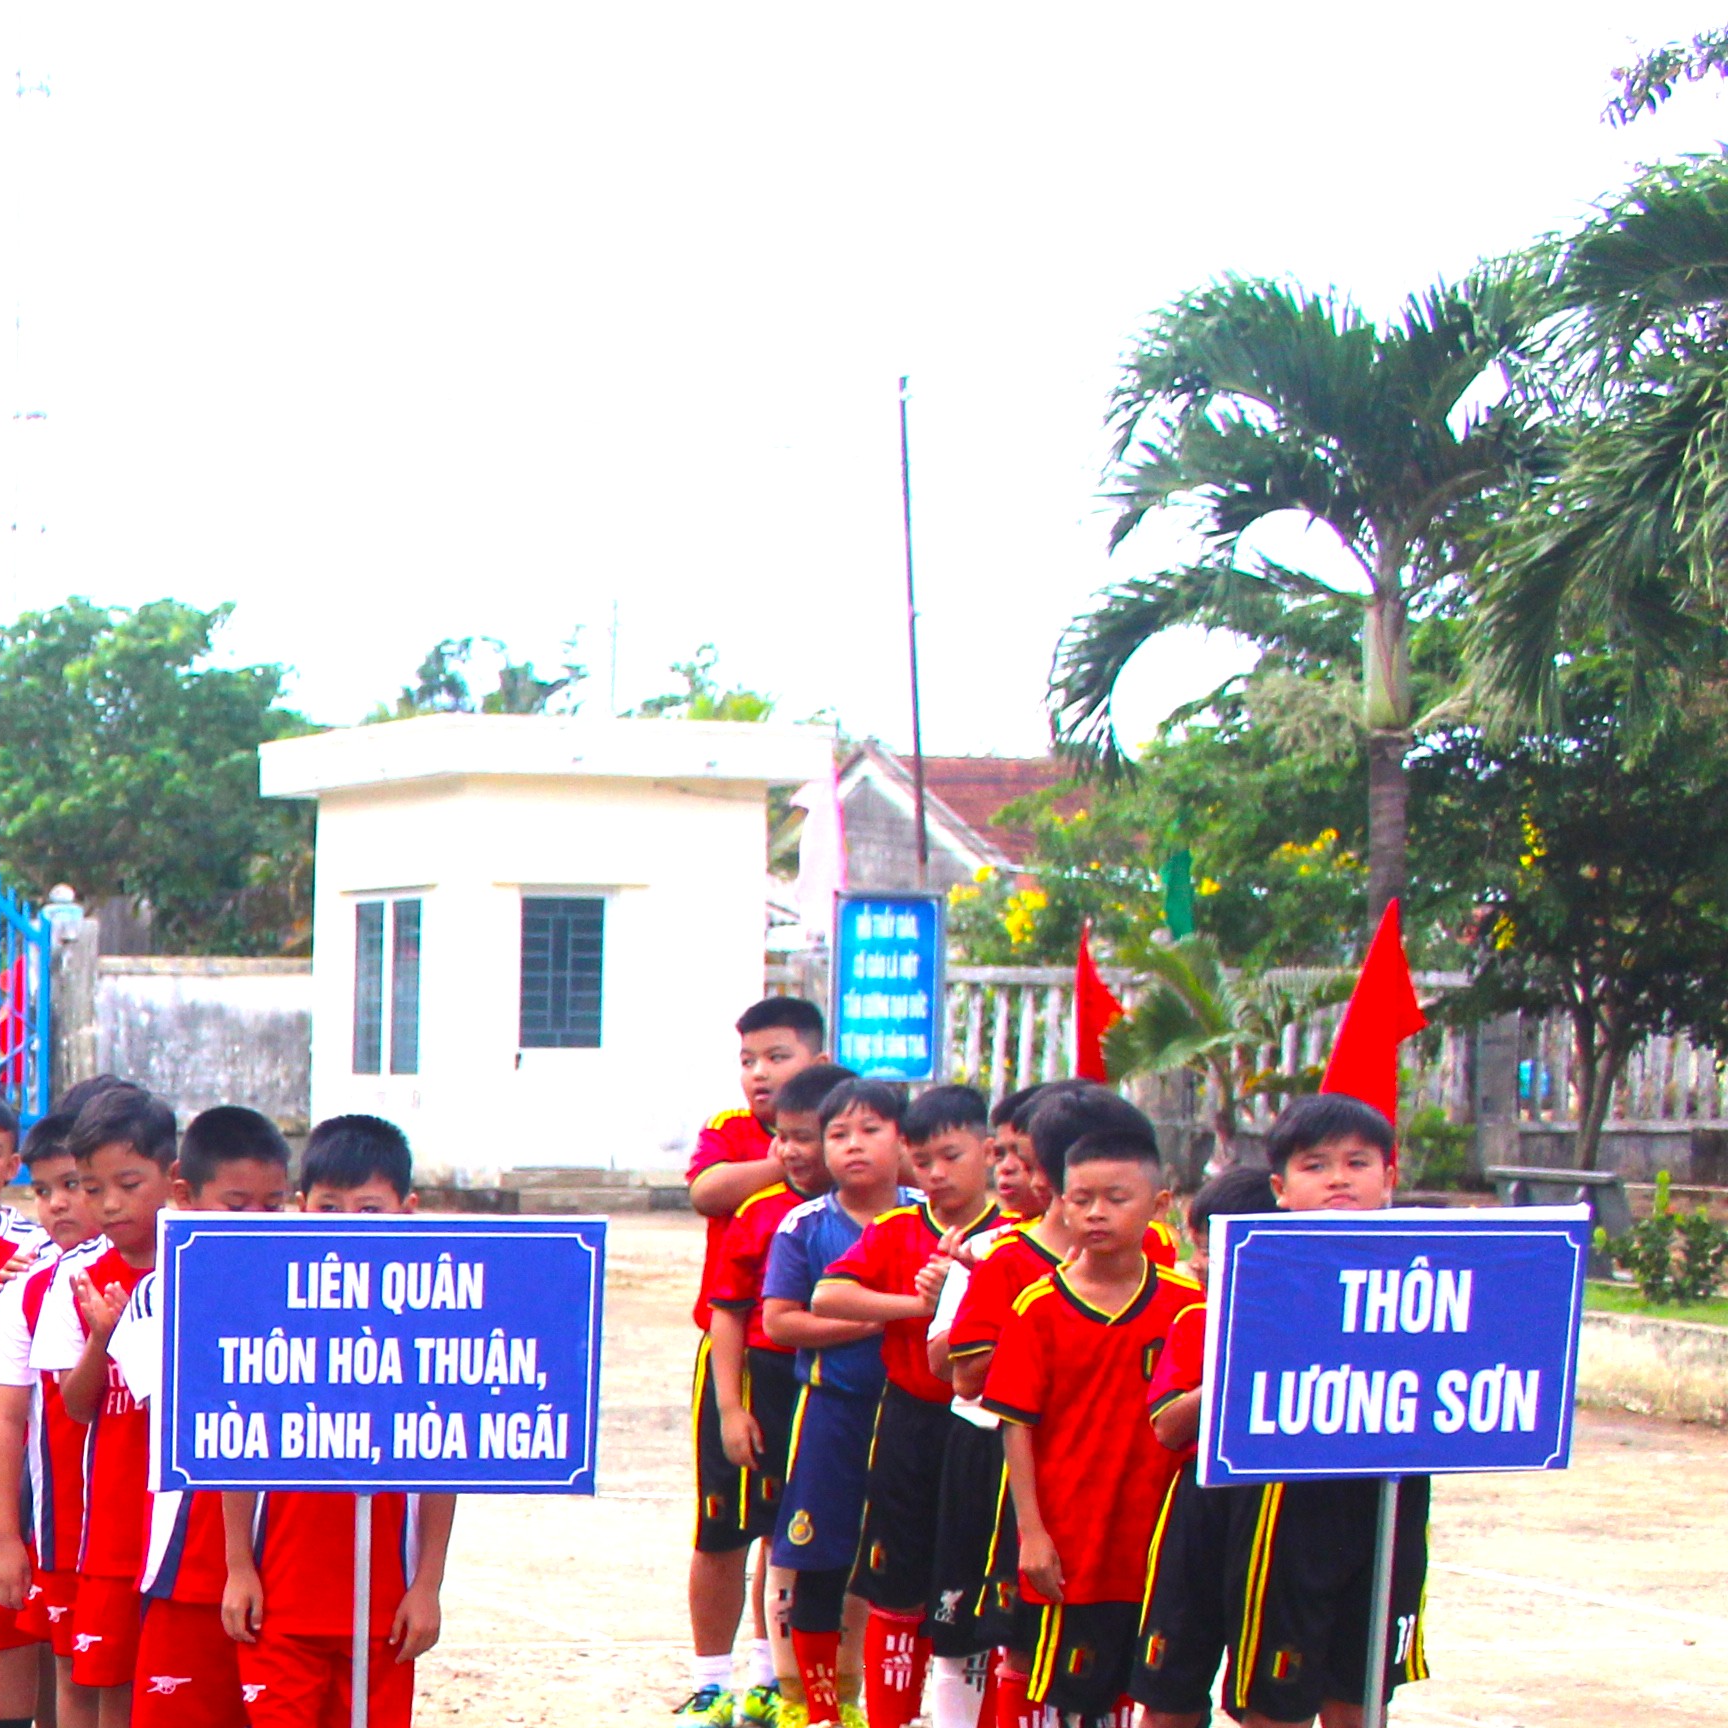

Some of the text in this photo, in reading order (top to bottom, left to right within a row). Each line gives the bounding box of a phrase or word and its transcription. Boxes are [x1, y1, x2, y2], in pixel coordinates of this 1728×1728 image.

[287, 1252, 483, 1315] LIÊN QUÂN
[1339, 1256, 1472, 1333] THÔN
[218, 1326, 546, 1395] THÔN HÒA THUẬN,
[195, 1401, 568, 1465] HÒA BÌNH, HÒA NGÃI
[1249, 1363, 1539, 1435] LƯƠNG SƠN
